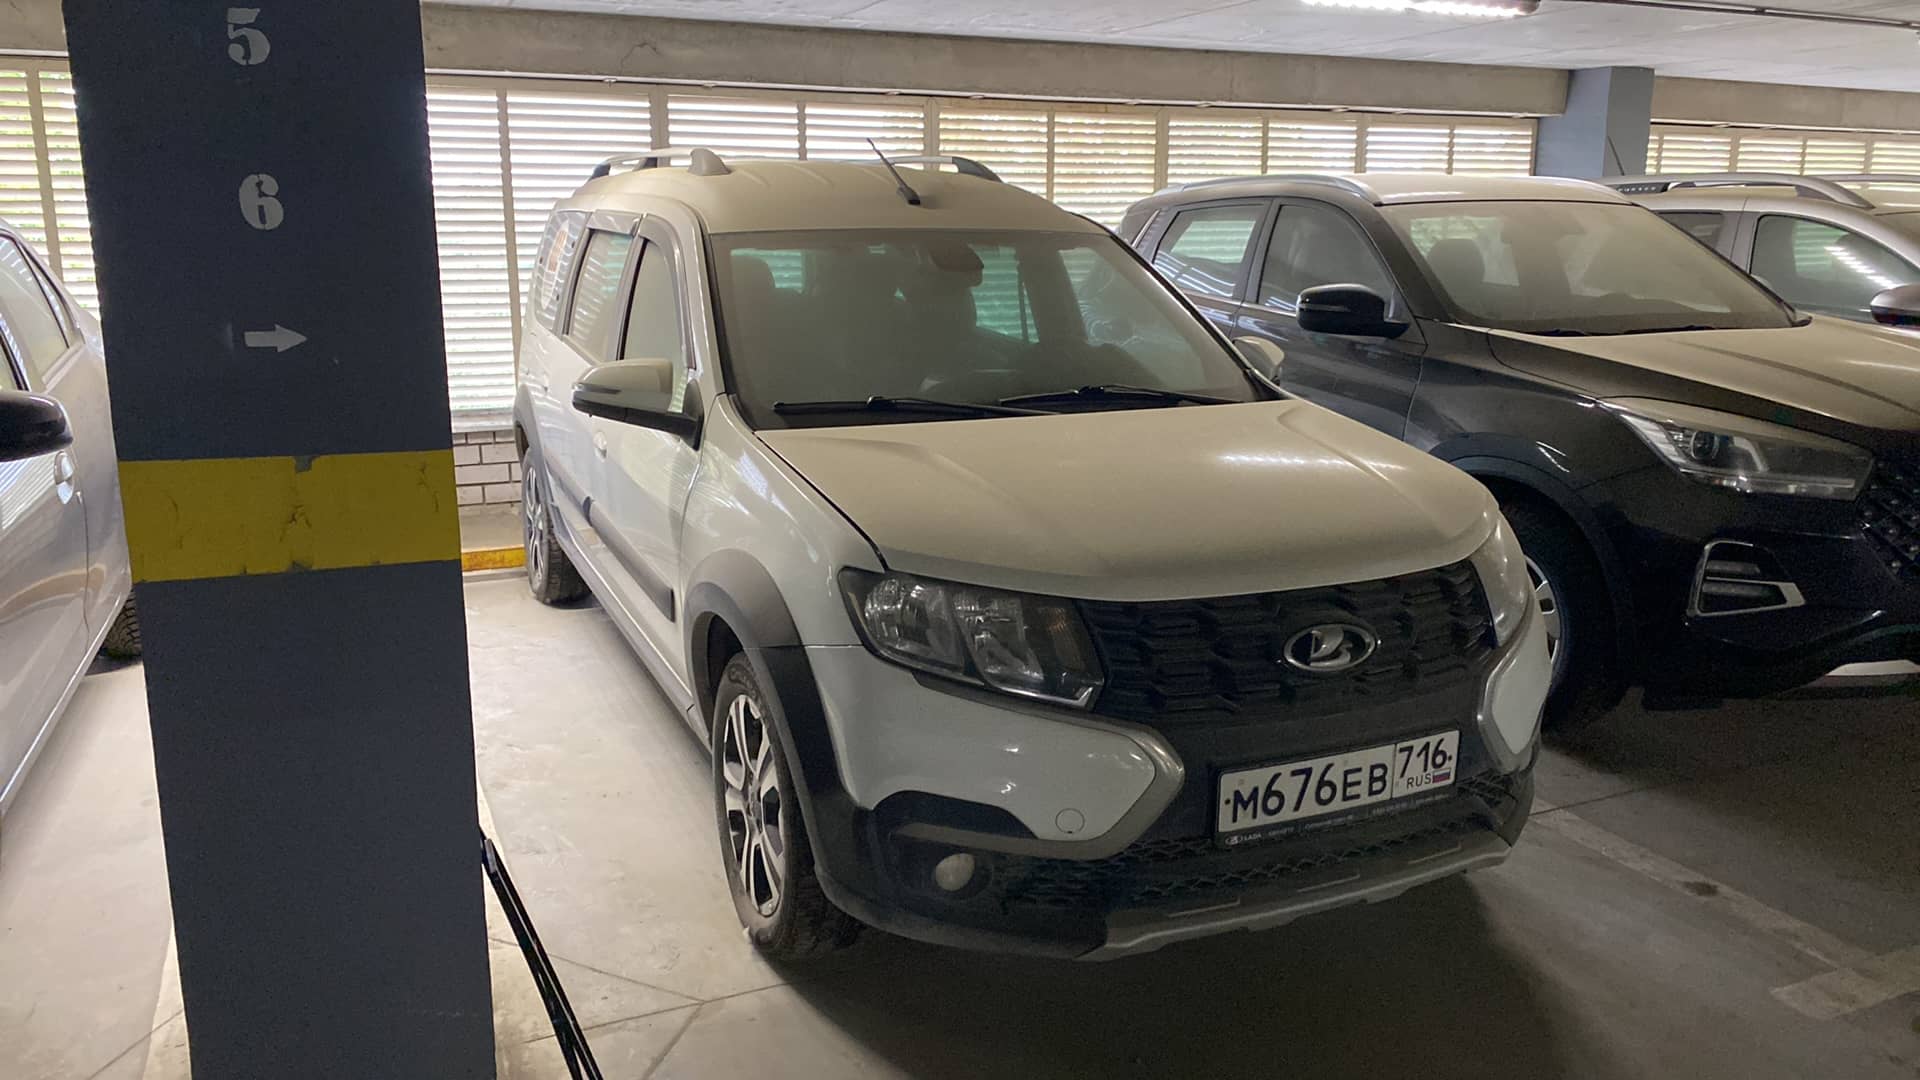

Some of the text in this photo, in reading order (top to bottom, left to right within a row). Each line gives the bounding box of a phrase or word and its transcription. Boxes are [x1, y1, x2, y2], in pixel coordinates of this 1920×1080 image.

[227, 8, 270, 65] 5
[238, 173, 284, 230] 6
[1397, 738, 1448, 778] 716
[1406, 773, 1432, 790] RUS
